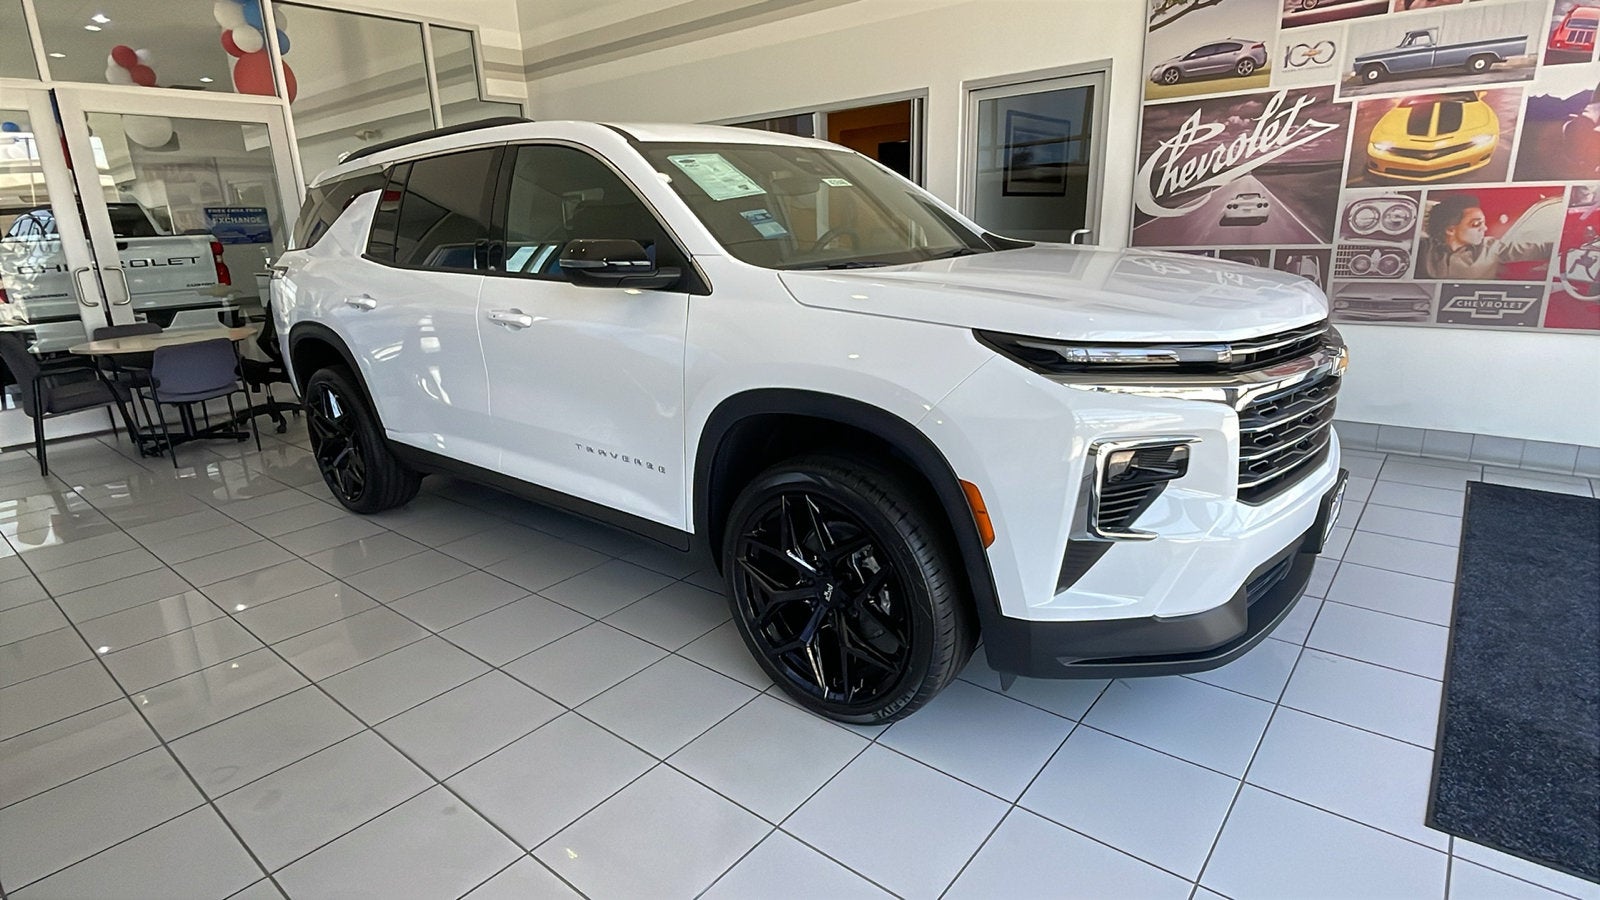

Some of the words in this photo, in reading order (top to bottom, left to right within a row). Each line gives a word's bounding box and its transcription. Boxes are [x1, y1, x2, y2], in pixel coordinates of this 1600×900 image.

[1283, 40, 1336, 68] 100
[1134, 88, 1340, 218] Chevrolet
[17, 256, 200, 274] CHOLET
[1456, 300, 1523, 309] CHEVROLET
[575, 443, 666, 474] TRAVERSE
